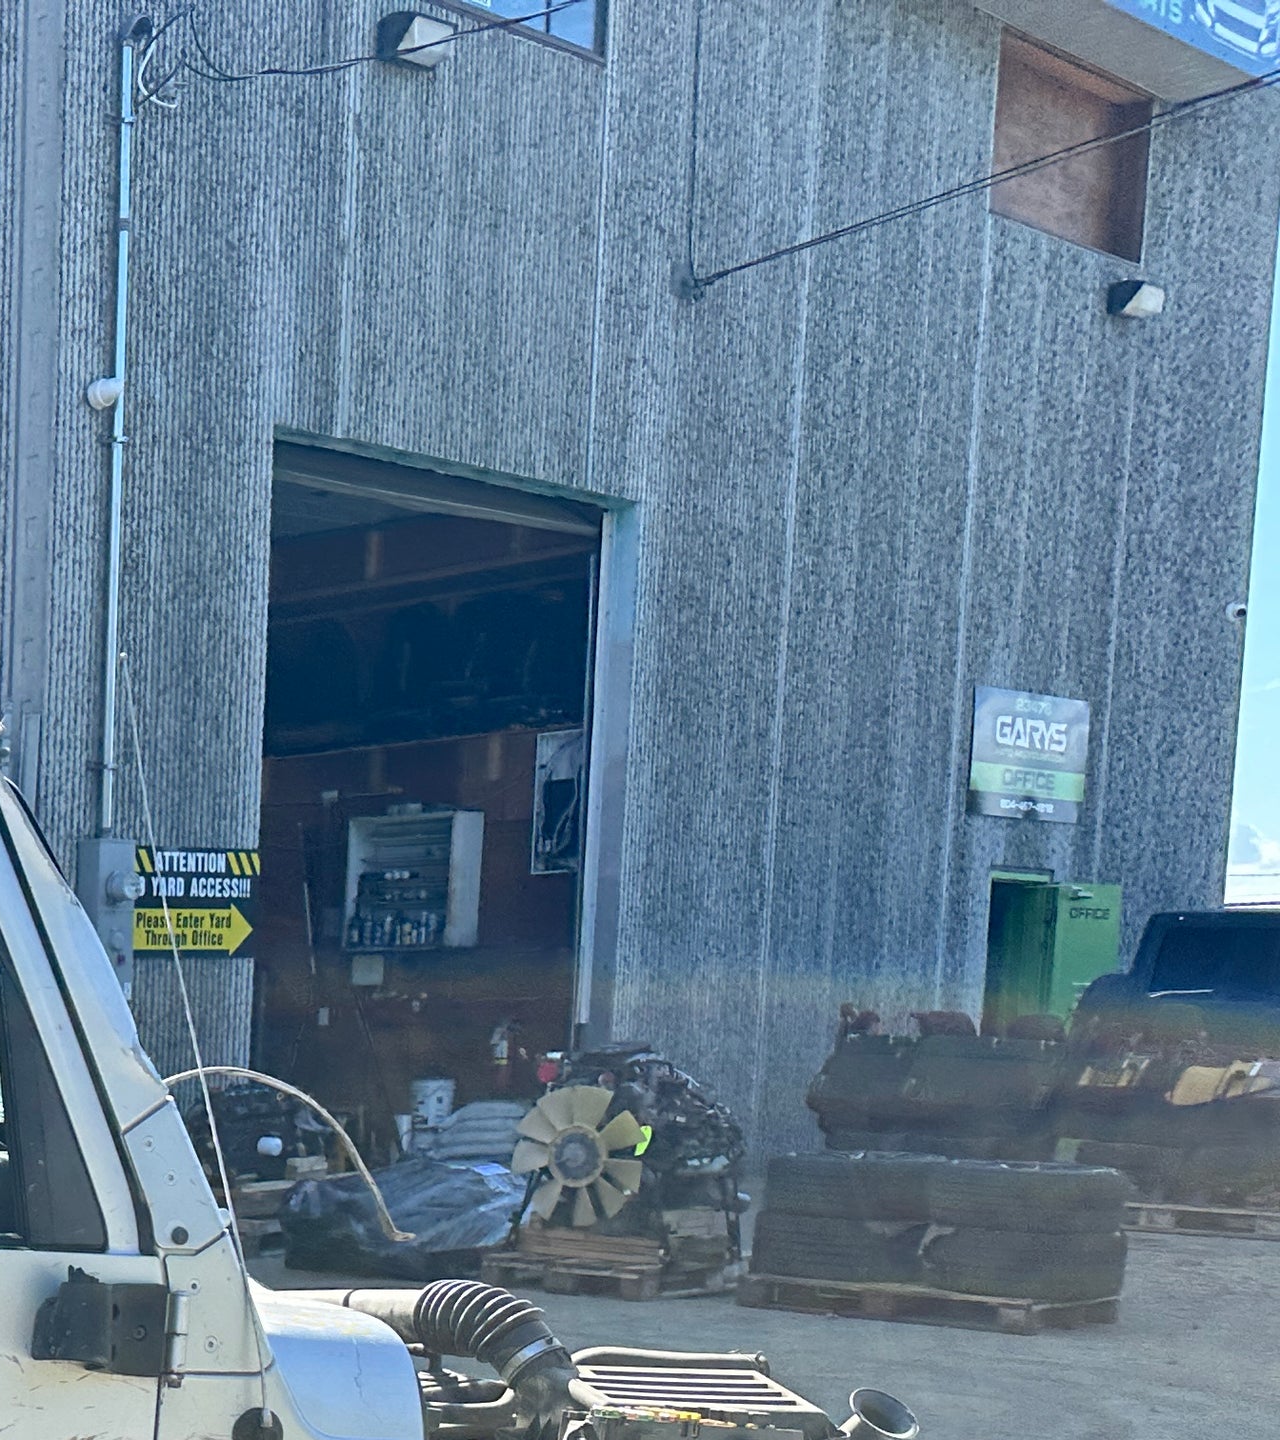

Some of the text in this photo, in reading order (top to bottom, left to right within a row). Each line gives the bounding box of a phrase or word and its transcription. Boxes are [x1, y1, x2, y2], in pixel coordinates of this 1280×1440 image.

[996, 715, 1068, 752] GARYS
[1003, 768, 1055, 791] OFFICE
[154, 851, 226, 873] ATTENTION
[151, 876, 185, 897] YARD
[189, 877, 251, 898] ACCESS!!!
[176, 912, 205, 928] Enter
[209, 912, 232, 928] Yard
[191, 930, 223, 946] Office
